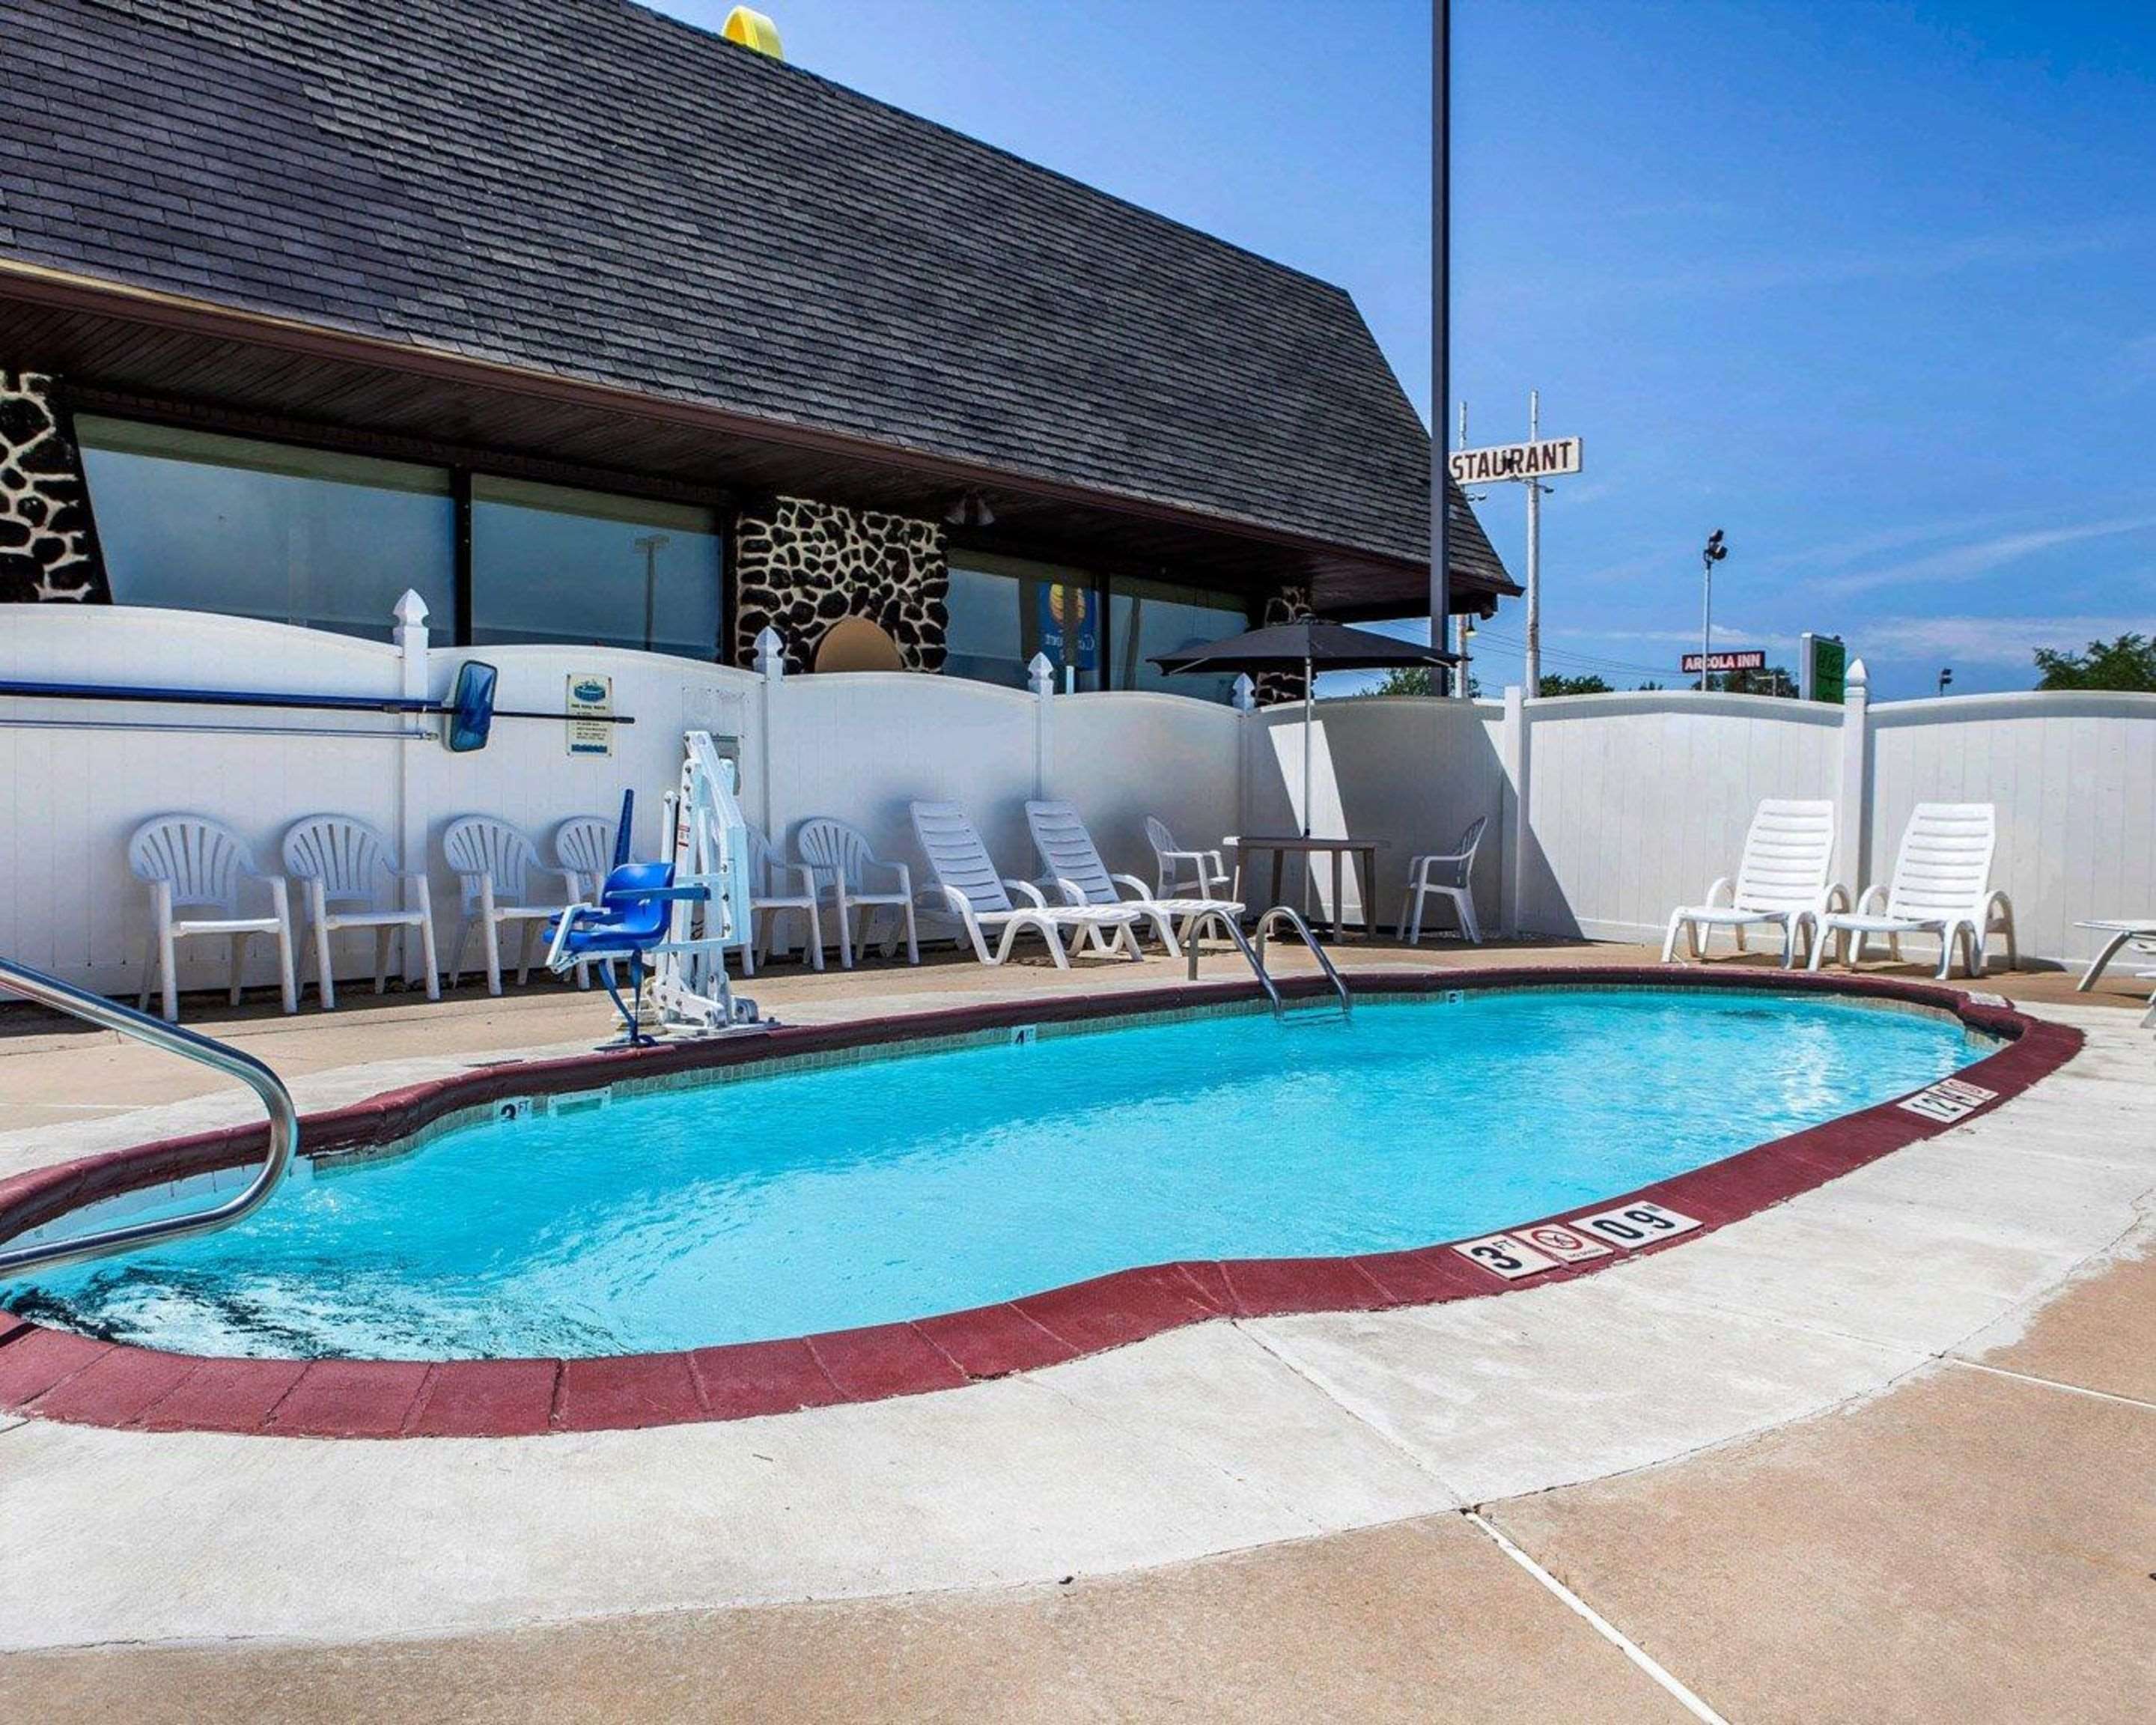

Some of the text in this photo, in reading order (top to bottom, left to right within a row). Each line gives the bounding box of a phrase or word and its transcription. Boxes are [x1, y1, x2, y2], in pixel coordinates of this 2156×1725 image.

[1452, 442, 1572, 480] STAURANT
[1738, 654, 1761, 667] INN
[1471, 1240, 1523, 1271] 3 FT
